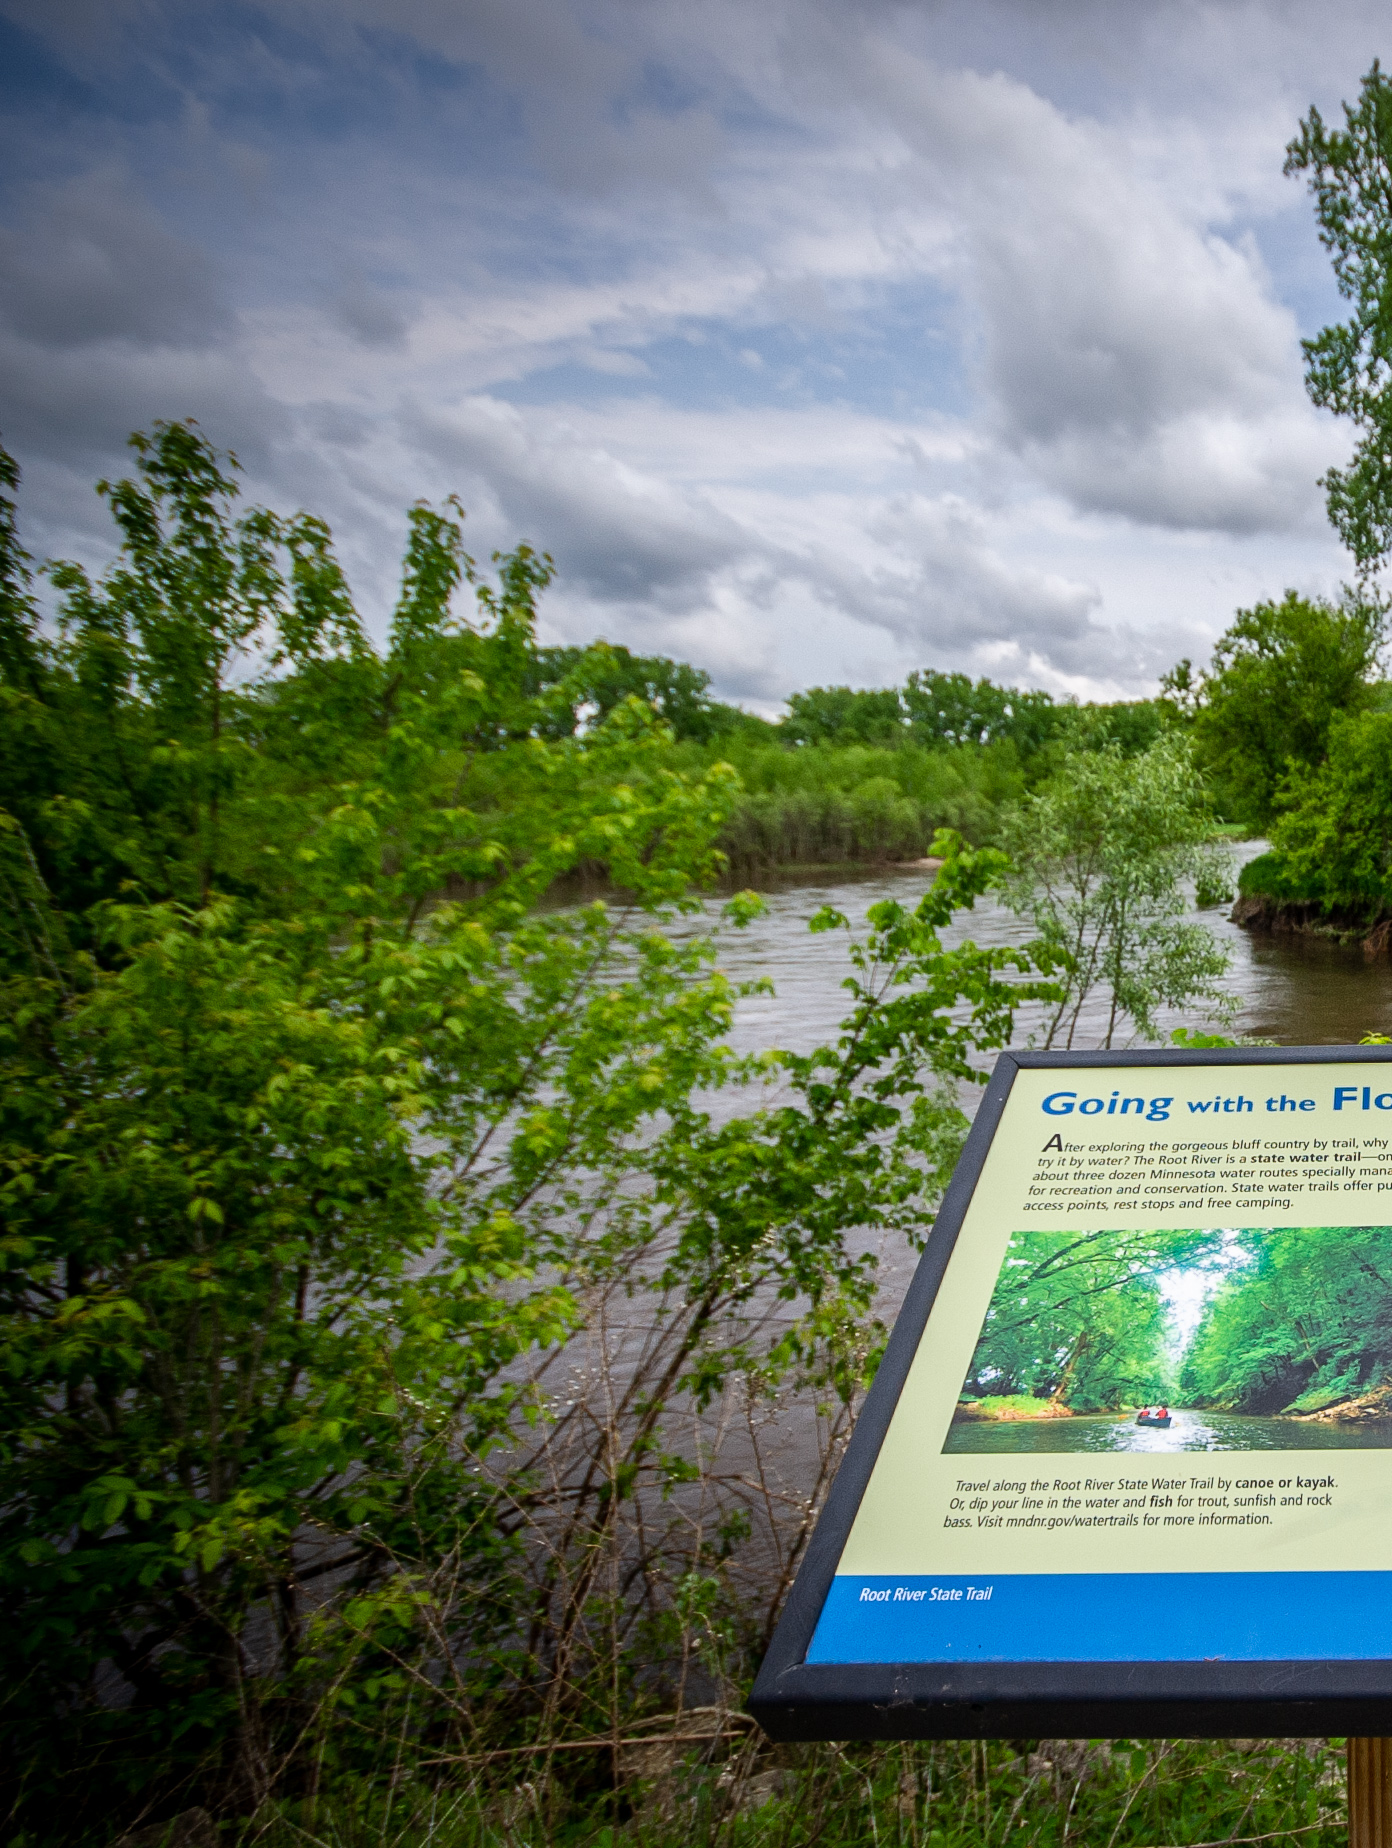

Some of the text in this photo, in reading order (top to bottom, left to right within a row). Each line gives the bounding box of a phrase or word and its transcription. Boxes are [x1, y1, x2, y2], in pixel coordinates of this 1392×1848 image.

[1041, 1090, 1174, 1122] Going
[1187, 1095, 1254, 1114] with
[1265, 1094, 1316, 1112] the
[1041, 1133, 1085, 1153] After
[1088, 1141, 1145, 1154] exploring
[1149, 1141, 1169, 1151] the
[1171, 1142, 1229, 1154] gorgeous
[1231, 1139, 1262, 1150] bluff
[1263, 1140, 1310, 1151] country
[1313, 1138, 1328, 1151] by
[1332, 1137, 1359, 1149] trail,
[1362, 1137, 1389, 1150] why
[1037, 1158, 1055, 1169] try
[1057, 1157, 1067, 1167] it
[1069, 1156, 1085, 1169] by
[1088, 1155, 1131, 1166] water?
[1133, 1155, 1155, 1165] The
[1158, 1155, 1188, 1165] Root
[1191, 1154, 1223, 1165] River
[1225, 1153, 1236, 1164] is
[1239, 1155, 1247, 1164] a
[1250, 1154, 1285, 1164] state
[1289, 1153, 1330, 1163] water
[1032, 1170, 1070, 1181] about
[1073, 1170, 1105, 1181] three
[1108, 1169, 1146, 1180] dozen
[1150, 1168, 1216, 1179] Minnesota
[1219, 1169, 1256, 1179] water
[1259, 1168, 1298, 1178] routes
[1302, 1165, 1356, 1180] specially
[1028, 1184, 1047, 1196] for
[1049, 1184, 1113, 1196] recreation
[1116, 1183, 1141, 1195] and
[1144, 1182, 1227, 1194] conservation.
[1231, 1182, 1264, 1193] State
[1268, 1182, 1305, 1193] water
[1308, 1180, 1340, 1192] trails
[1343, 1179, 1374, 1191] offer
[1022, 1196, 1294, 1213] access points, rest stops and free camping.
[956, 1475, 1338, 1495] Travel along the Root River State Water Trail by canoe or kayak.
[949, 1492, 1333, 1513] Or, dip your line in the water and fish for trout, sunfish and rock
[943, 1512, 1273, 1531] bass. Visit mndnr.gov/watertrails for more information.
[859, 1585, 993, 1602] Root River State Trail
